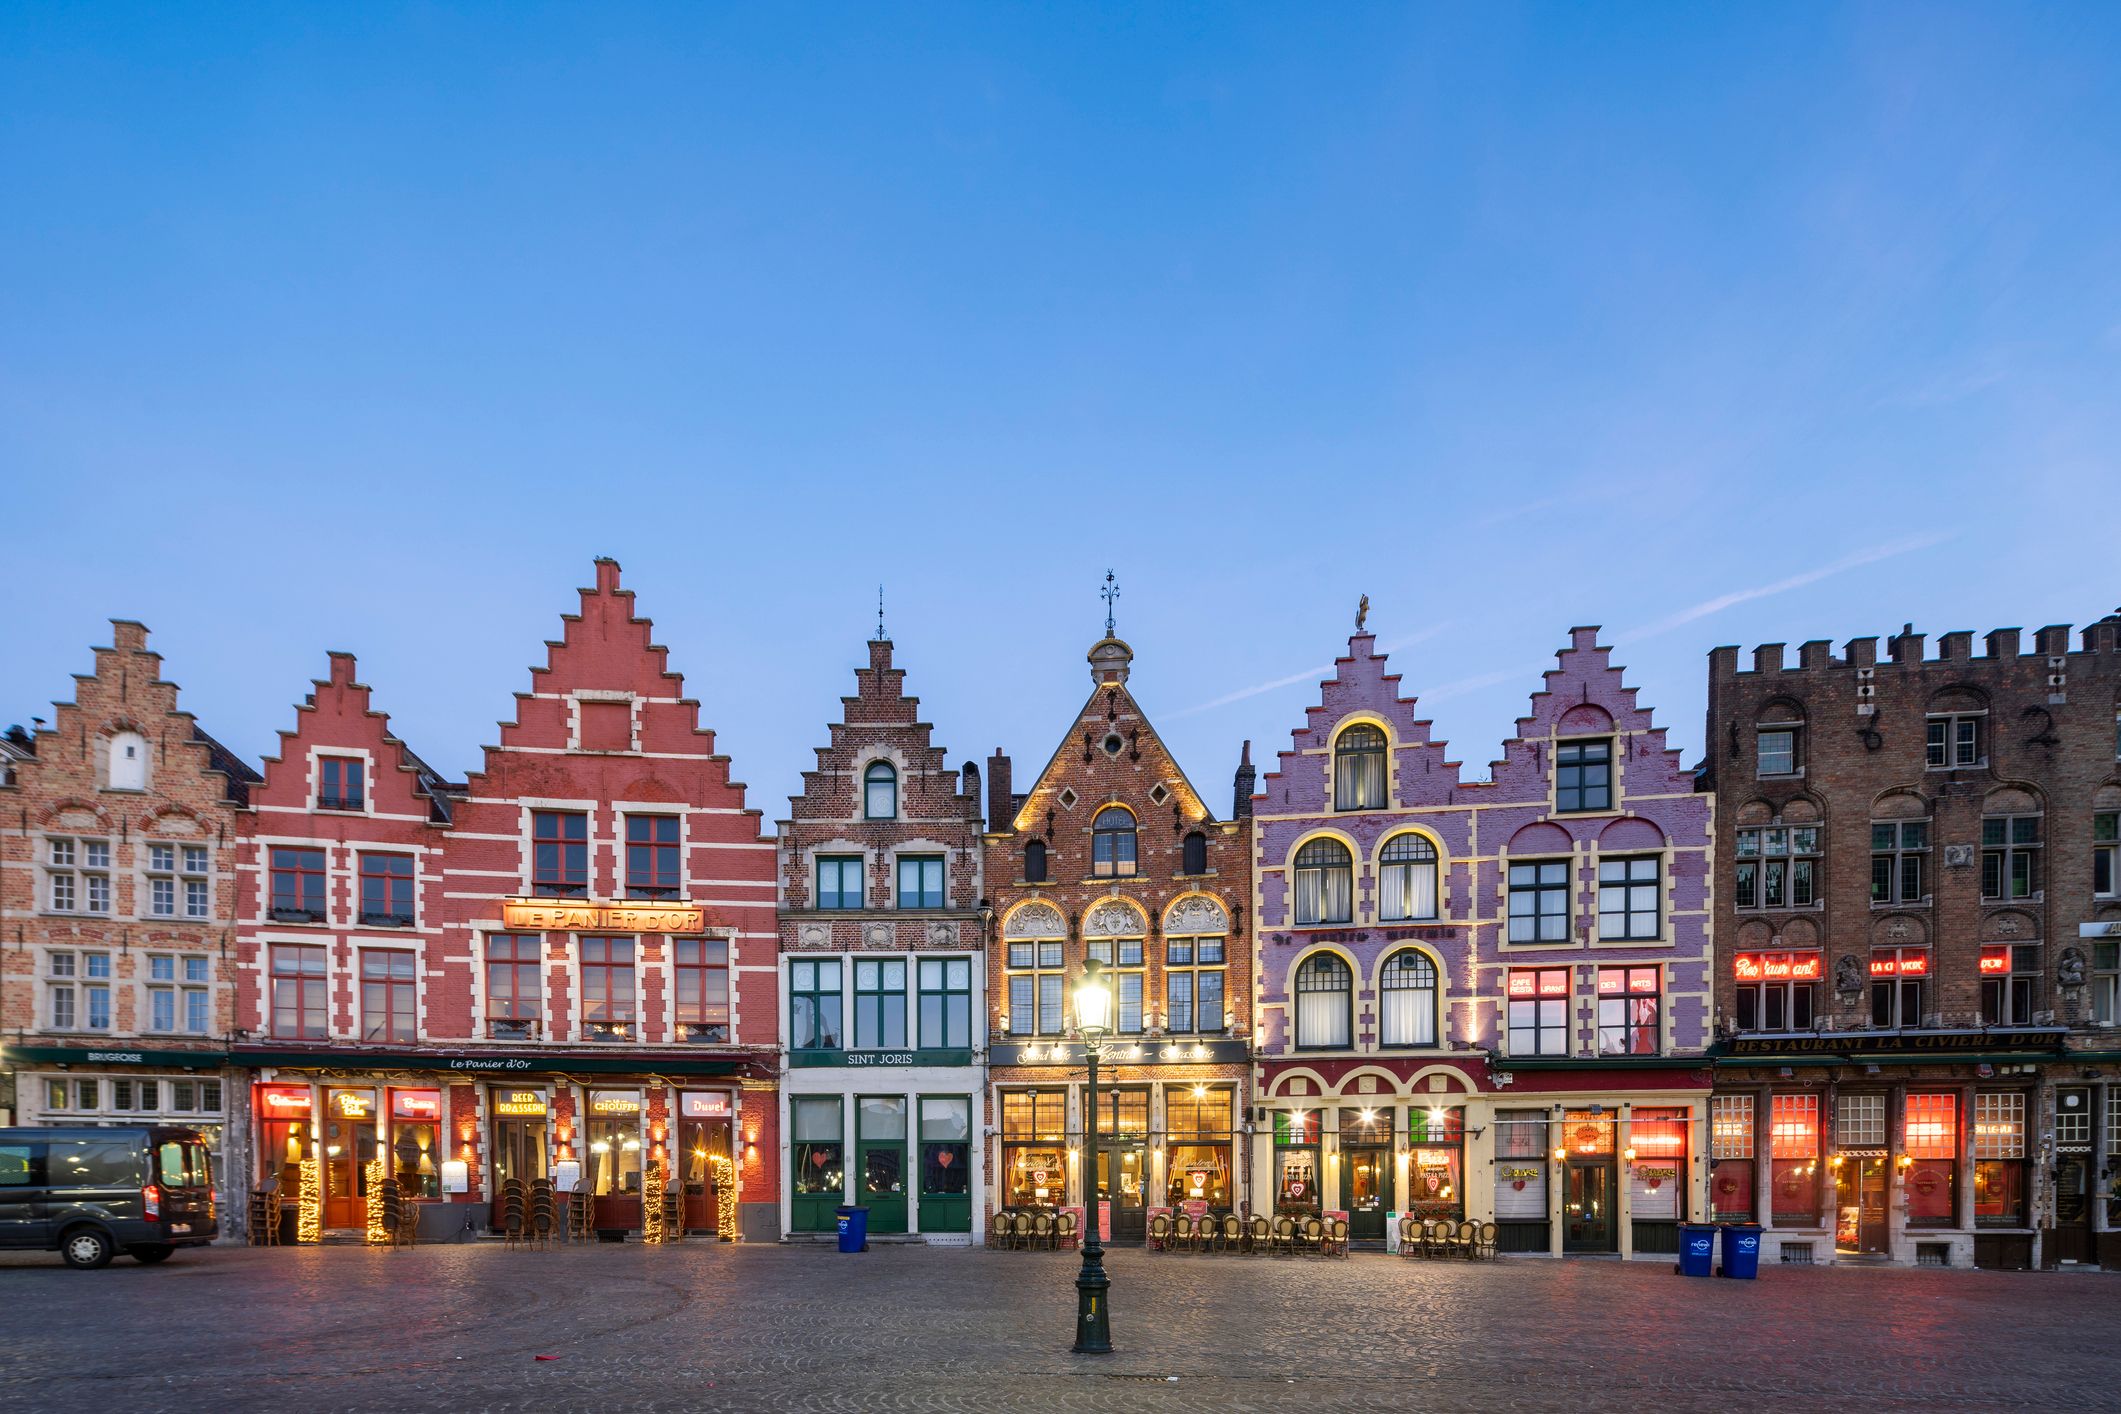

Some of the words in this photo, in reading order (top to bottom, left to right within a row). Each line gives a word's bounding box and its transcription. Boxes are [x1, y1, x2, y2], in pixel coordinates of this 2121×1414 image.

[513, 911, 543, 926] LE
[550, 909, 638, 929] PANIER
[645, 911, 700, 930] D'OR
[1631, 979, 1652, 988] ARTS
[1735, 1039, 1866, 1052] RESTAURANT
[1876, 1037, 1903, 1048] LA
[2009, 1033, 2057, 1046] D'OR
[88, 1052, 142, 1062] BRUGEOISE
[848, 1054, 875, 1065] SINT
[879, 1054, 913, 1064] JORIS
[450, 1059, 464, 1068] Le
[465, 1059, 504, 1069] Panier
[506, 1058, 532, 1069] d'Or
[511, 1093, 534, 1103] BEER
[500, 1103, 546, 1113] BRASSERIE
[594, 1102, 640, 1112] CHOUFFE
[693, 1100, 725, 1112] Duvel
